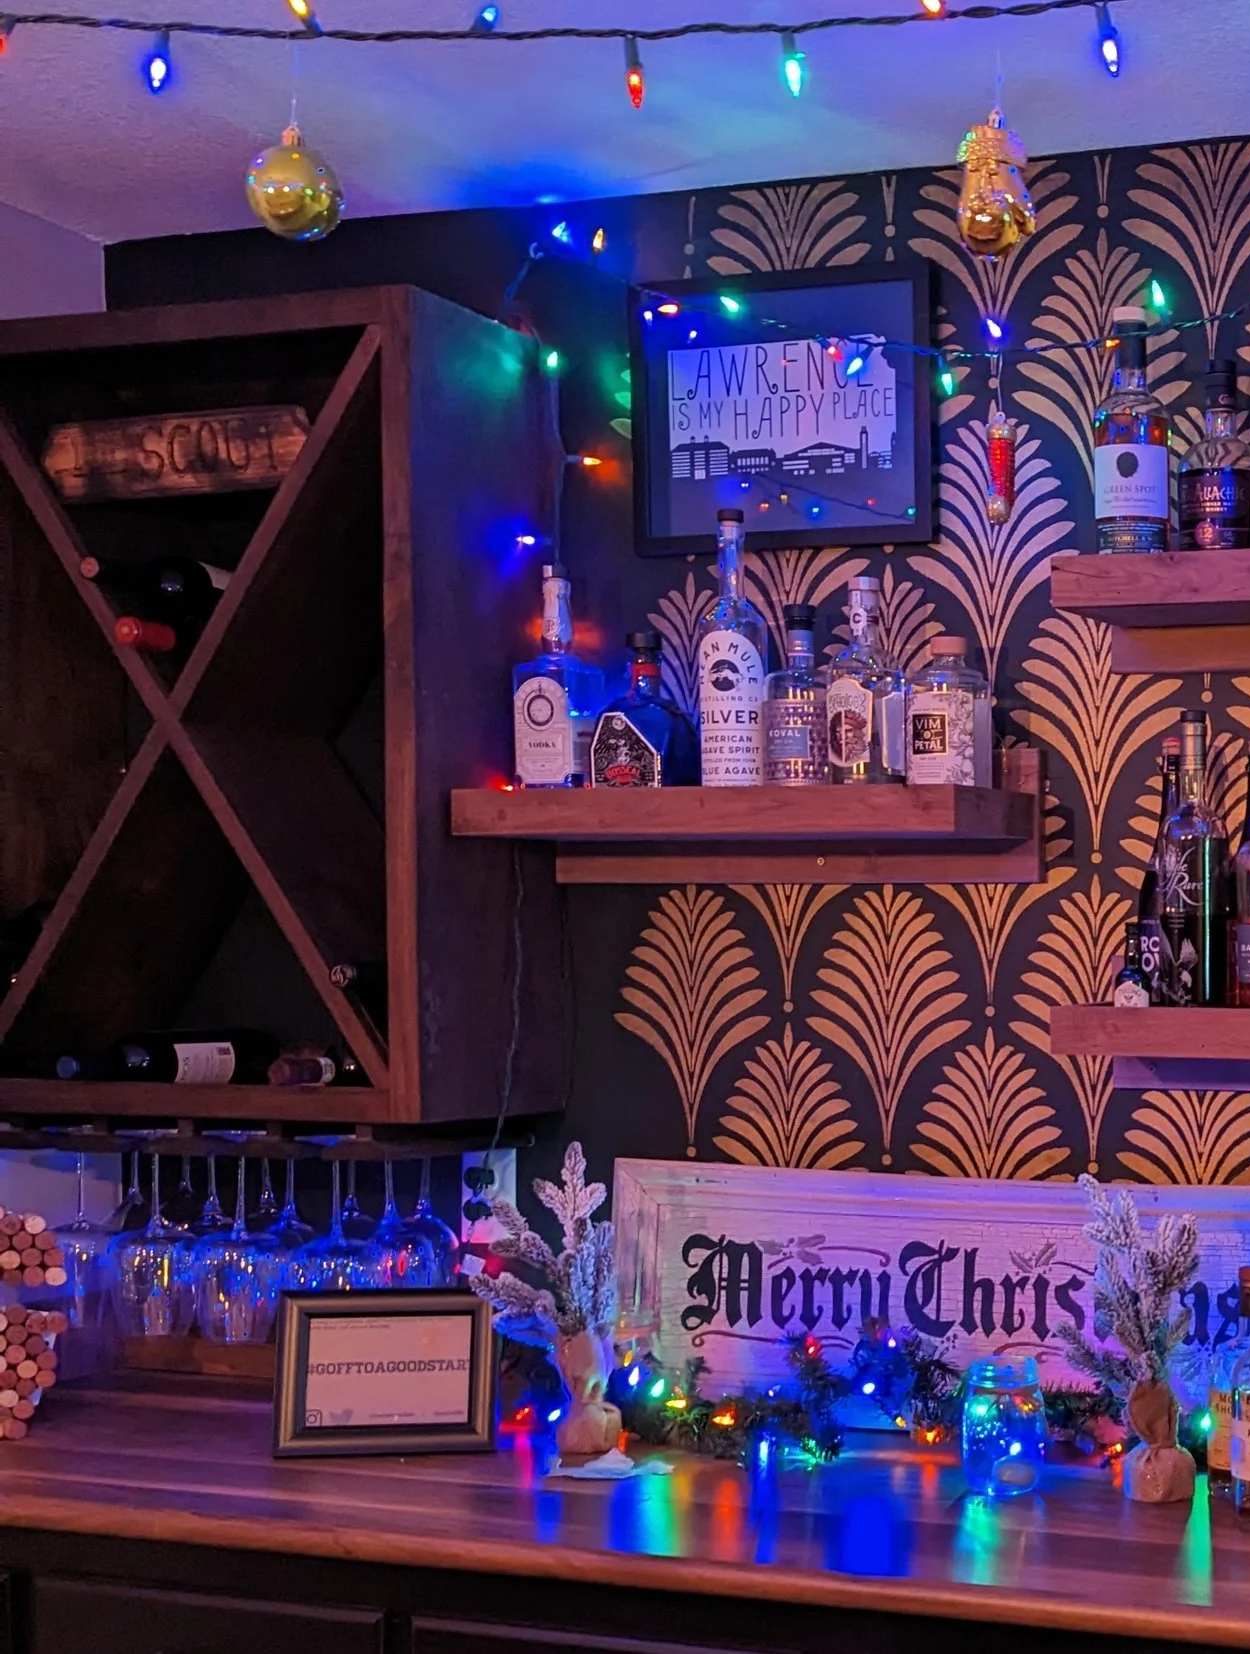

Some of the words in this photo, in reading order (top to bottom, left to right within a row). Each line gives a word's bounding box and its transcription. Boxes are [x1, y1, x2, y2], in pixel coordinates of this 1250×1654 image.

[672, 401, 691, 432] IS
[699, 402, 724, 429] MY
[734, 393, 825, 440] HAPPY
[832, 387, 895, 421] PLACE
[141, 420, 278, 480] SCOUT
[1104, 486, 1132, 495] GREEN
[1135, 485, 1157, 494] SPOT
[728, 642, 758, 685] MULE
[701, 710, 759, 725] SILVER
[915, 718, 942, 730] VIM
[528, 740, 557, 749] VODKA
[704, 735, 753, 743] AMERICAN
[702, 746, 725, 754] GAVE
[915, 740, 943, 752] PETAL
[724, 766, 760, 775] AGAVE
[1165, 871, 1206, 906] Rare
[681, 1233, 891, 1332] Merry
[308, 1358, 470, 1376] #GOFFTOAGOODSTAR
